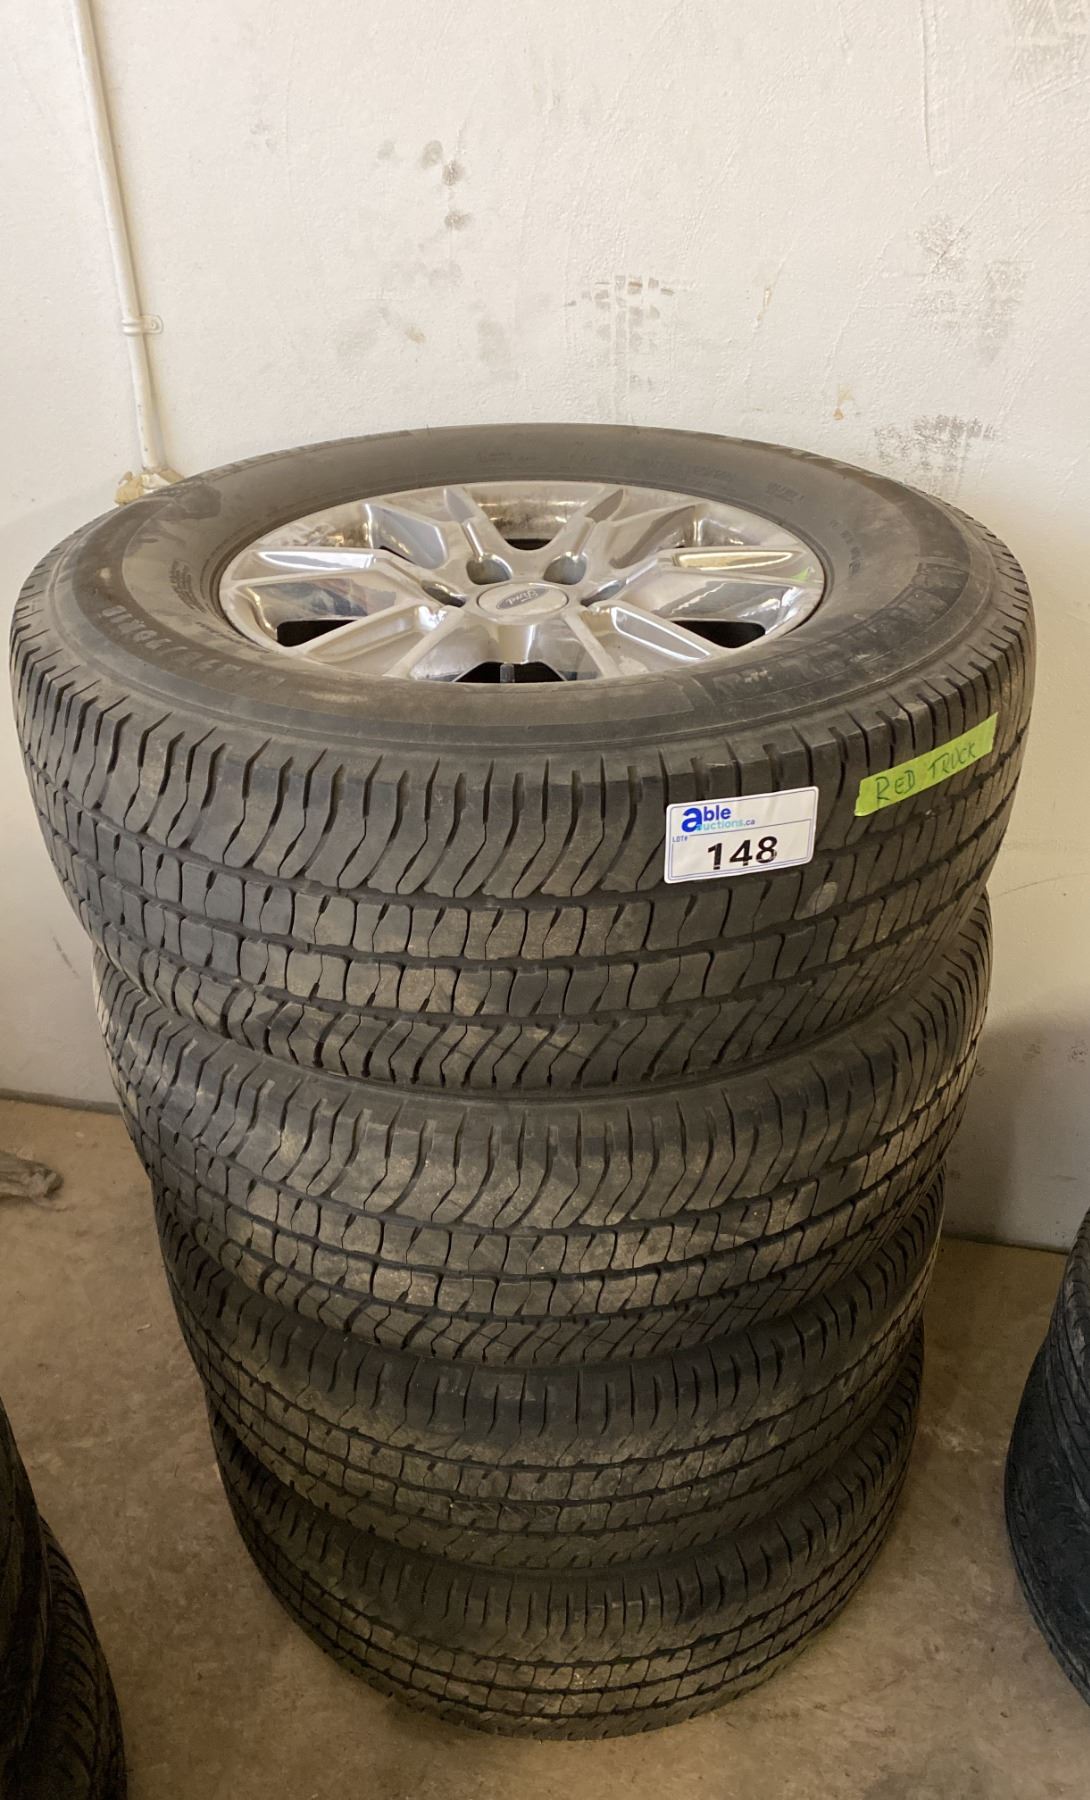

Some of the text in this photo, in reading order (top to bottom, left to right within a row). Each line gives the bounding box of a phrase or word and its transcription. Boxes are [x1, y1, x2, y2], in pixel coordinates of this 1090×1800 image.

[875, 742, 976, 806] RED TRUCK
[681, 805, 732, 833] able
[707, 836, 778, 870] 148
